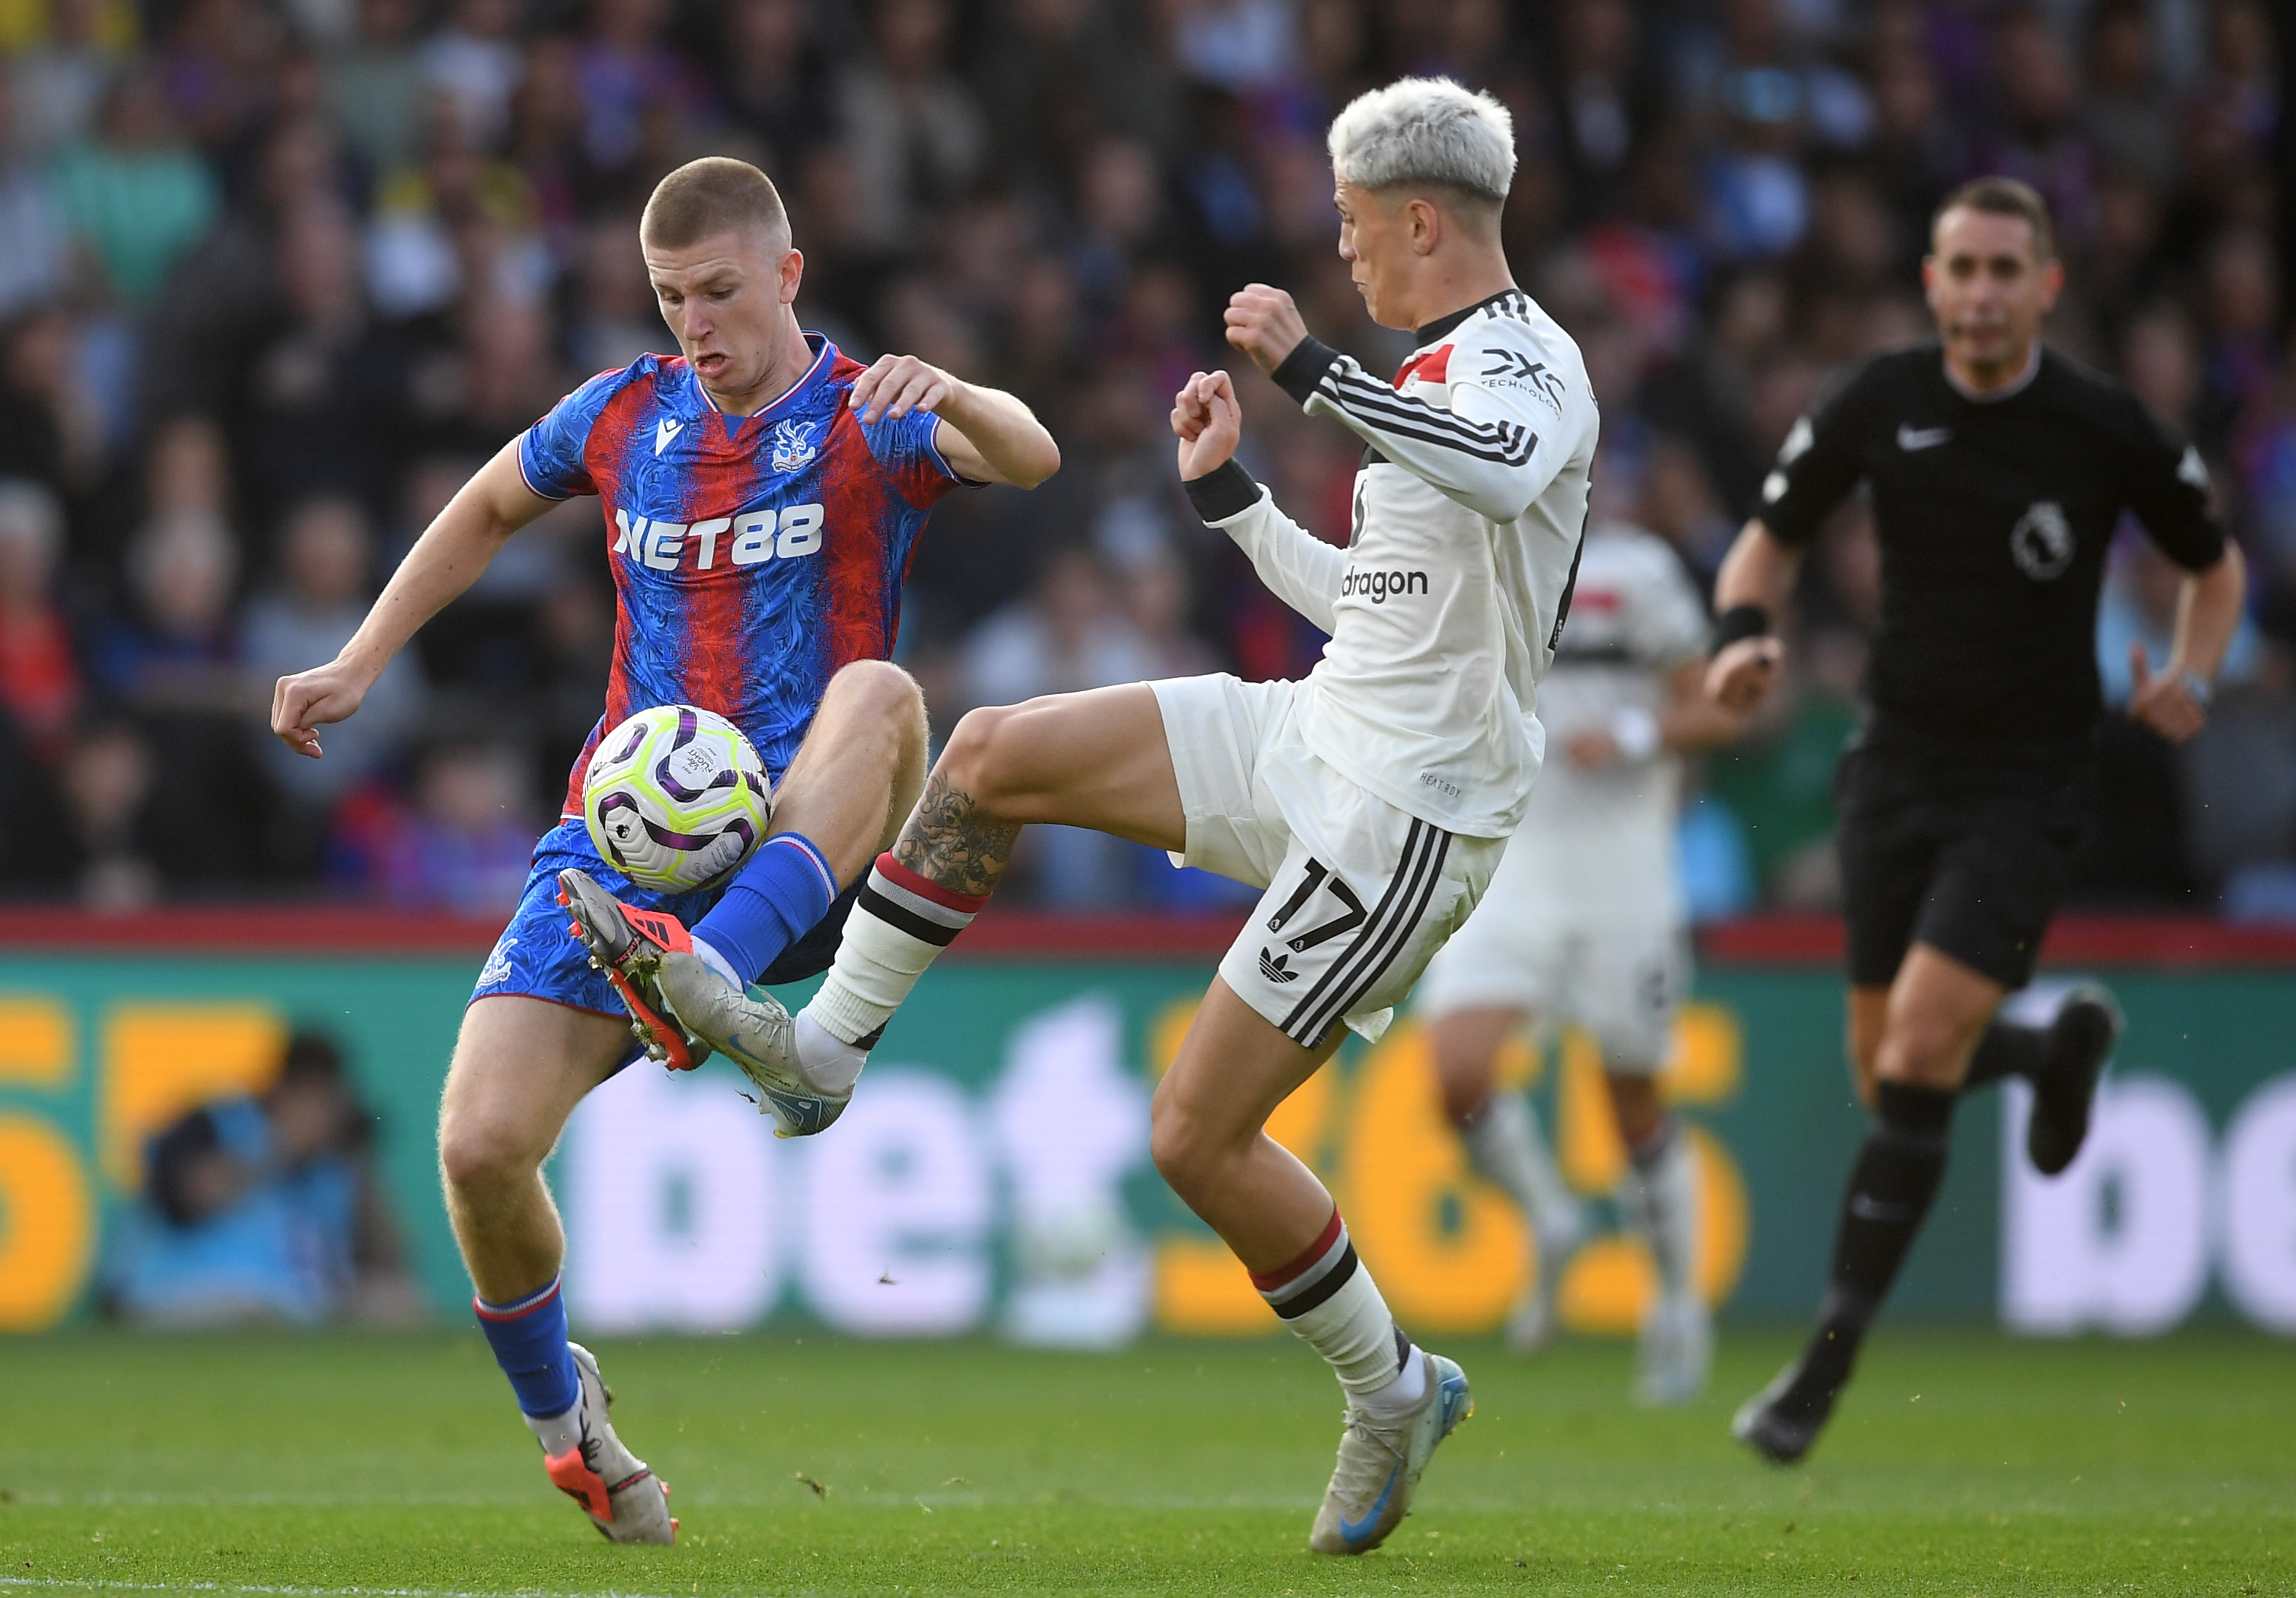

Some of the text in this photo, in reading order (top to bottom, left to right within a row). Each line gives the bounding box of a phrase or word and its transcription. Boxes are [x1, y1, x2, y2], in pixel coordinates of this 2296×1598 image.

[612, 503, 825, 571] NET88
[1341, 565, 1429, 605] dragon
[1420, 772, 1462, 798] HEAT.RDY
[1266, 856, 1368, 954] 17
